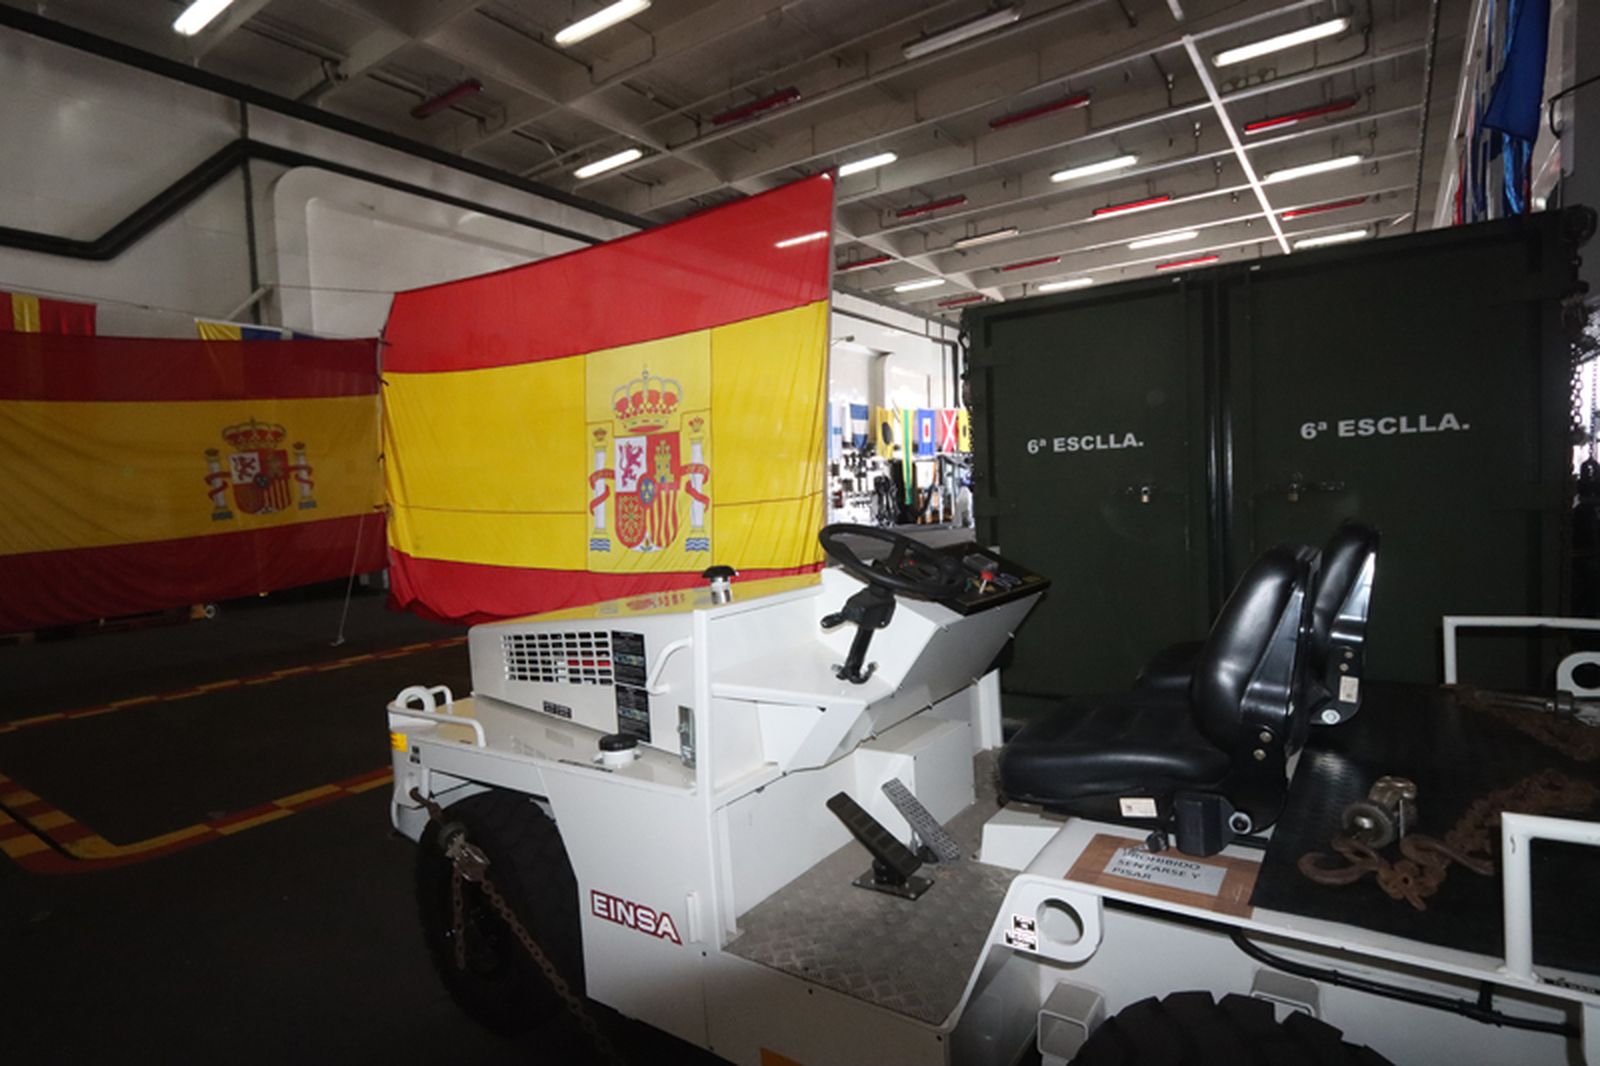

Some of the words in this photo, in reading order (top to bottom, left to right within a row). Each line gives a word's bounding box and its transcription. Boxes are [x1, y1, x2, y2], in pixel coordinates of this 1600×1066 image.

[1300, 421, 1327, 440] 6ª
[1338, 413, 1470, 437] ESCLLA.
[1027, 438, 1047, 454] 6ª
[1053, 433, 1144, 452] ESCLLA.
[1112, 867, 1152, 880] PISAR
[591, 889, 683, 945] EINSA
